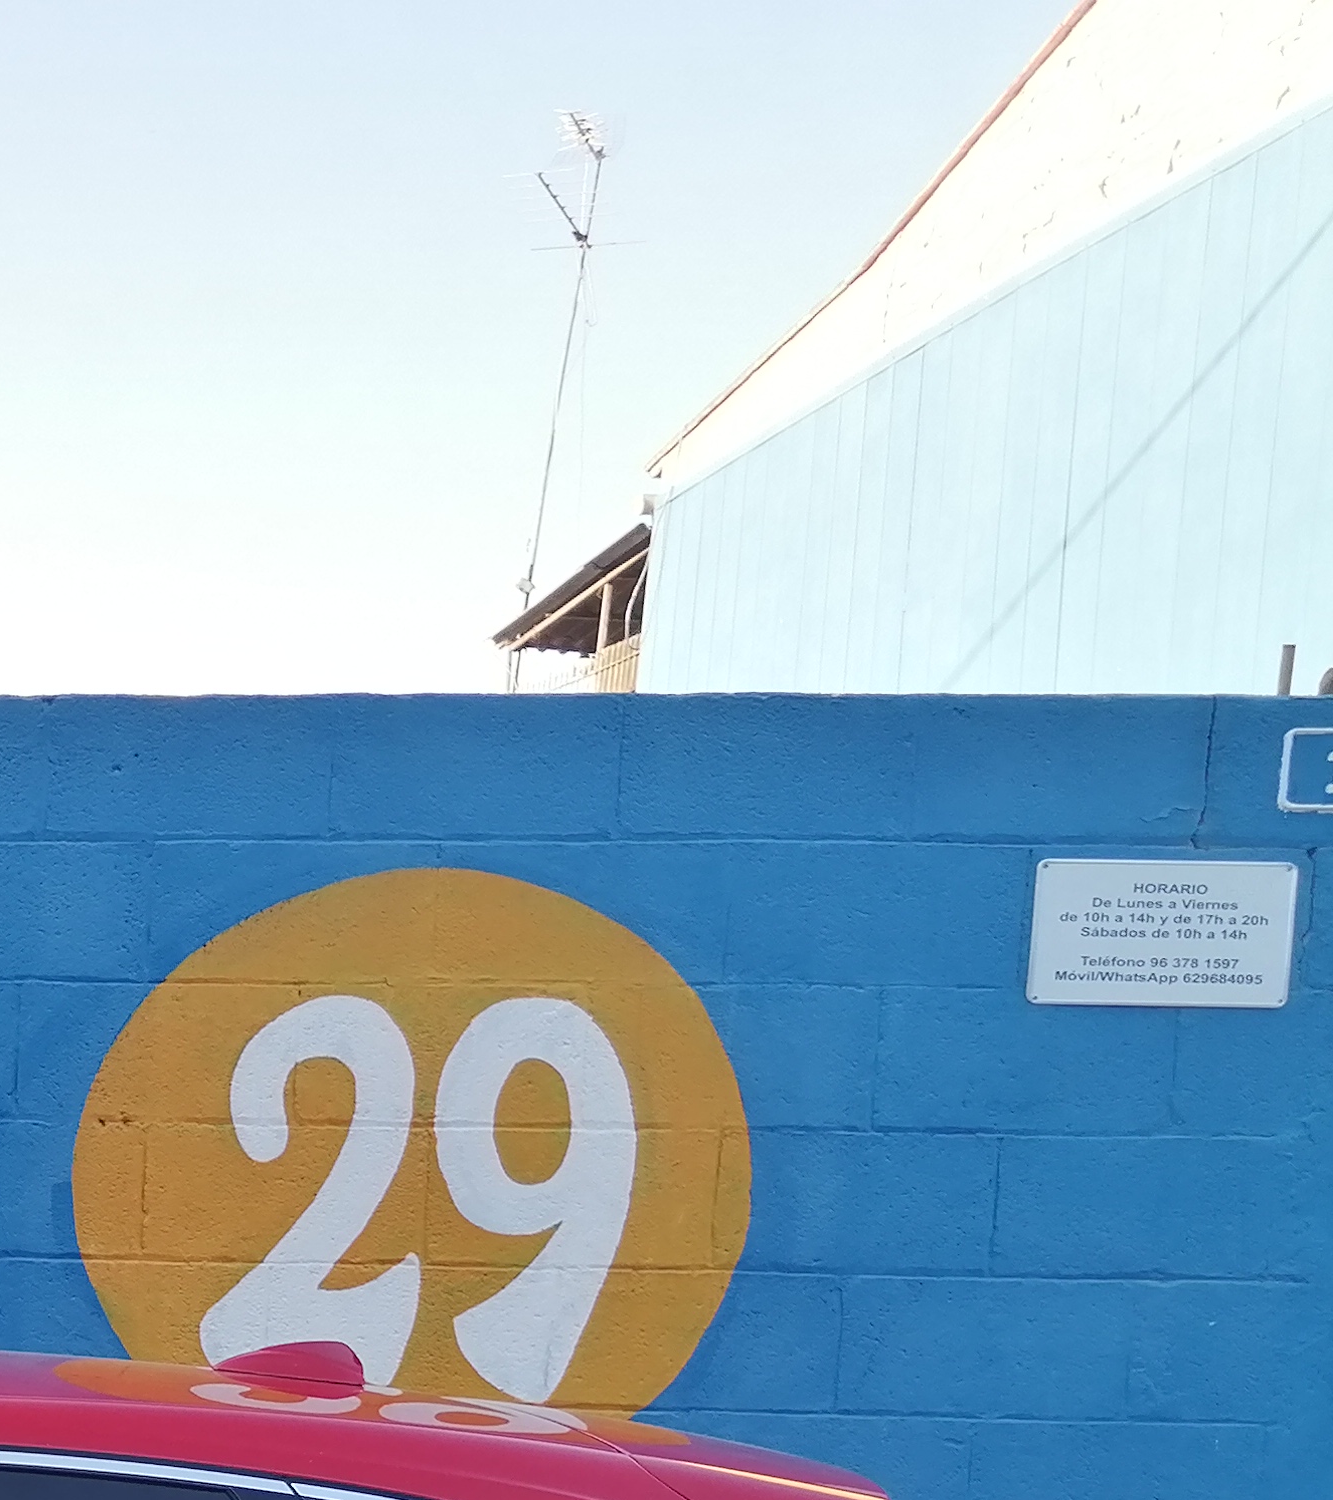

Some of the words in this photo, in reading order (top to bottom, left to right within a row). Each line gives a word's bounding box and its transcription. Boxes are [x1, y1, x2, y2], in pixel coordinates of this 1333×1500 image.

[1133, 883, 1208, 895] HORARIO
[1092, 897, 1112, 908] De
[1117, 898, 1163, 909] Lunes
[1168, 901, 1177, 910] a
[1181, 899, 1238, 911] Viernes
[1060, 912, 1078, 923] de
[1083, 912, 1110, 923] 10h
[1114, 915, 1123, 923] a
[1130, 913, 1155, 924] 14h
[1159, 915, 1168, 926] y
[1173, 914, 1192, 925] de
[1198, 914, 1224, 925] 17h
[1228, 916, 1237, 925] a
[1242, 915, 1269, 926] 20h
[1080, 927, 1146, 938] Sábados
[1152, 928, 1170, 939] de
[1176, 928, 1202, 939] 10h
[1206, 931, 1215, 940] a
[1221, 929, 1247, 940] 14h
[1080, 956, 1146, 968] Teléfono
[1150, 957, 1168, 968] 96
[1172, 957, 1199, 968] 378
[1204, 958, 1239, 969] 1597
[1054, 970, 1178, 985] Móvil/WhatsApp
[199, 995, 638, 1404] 29
